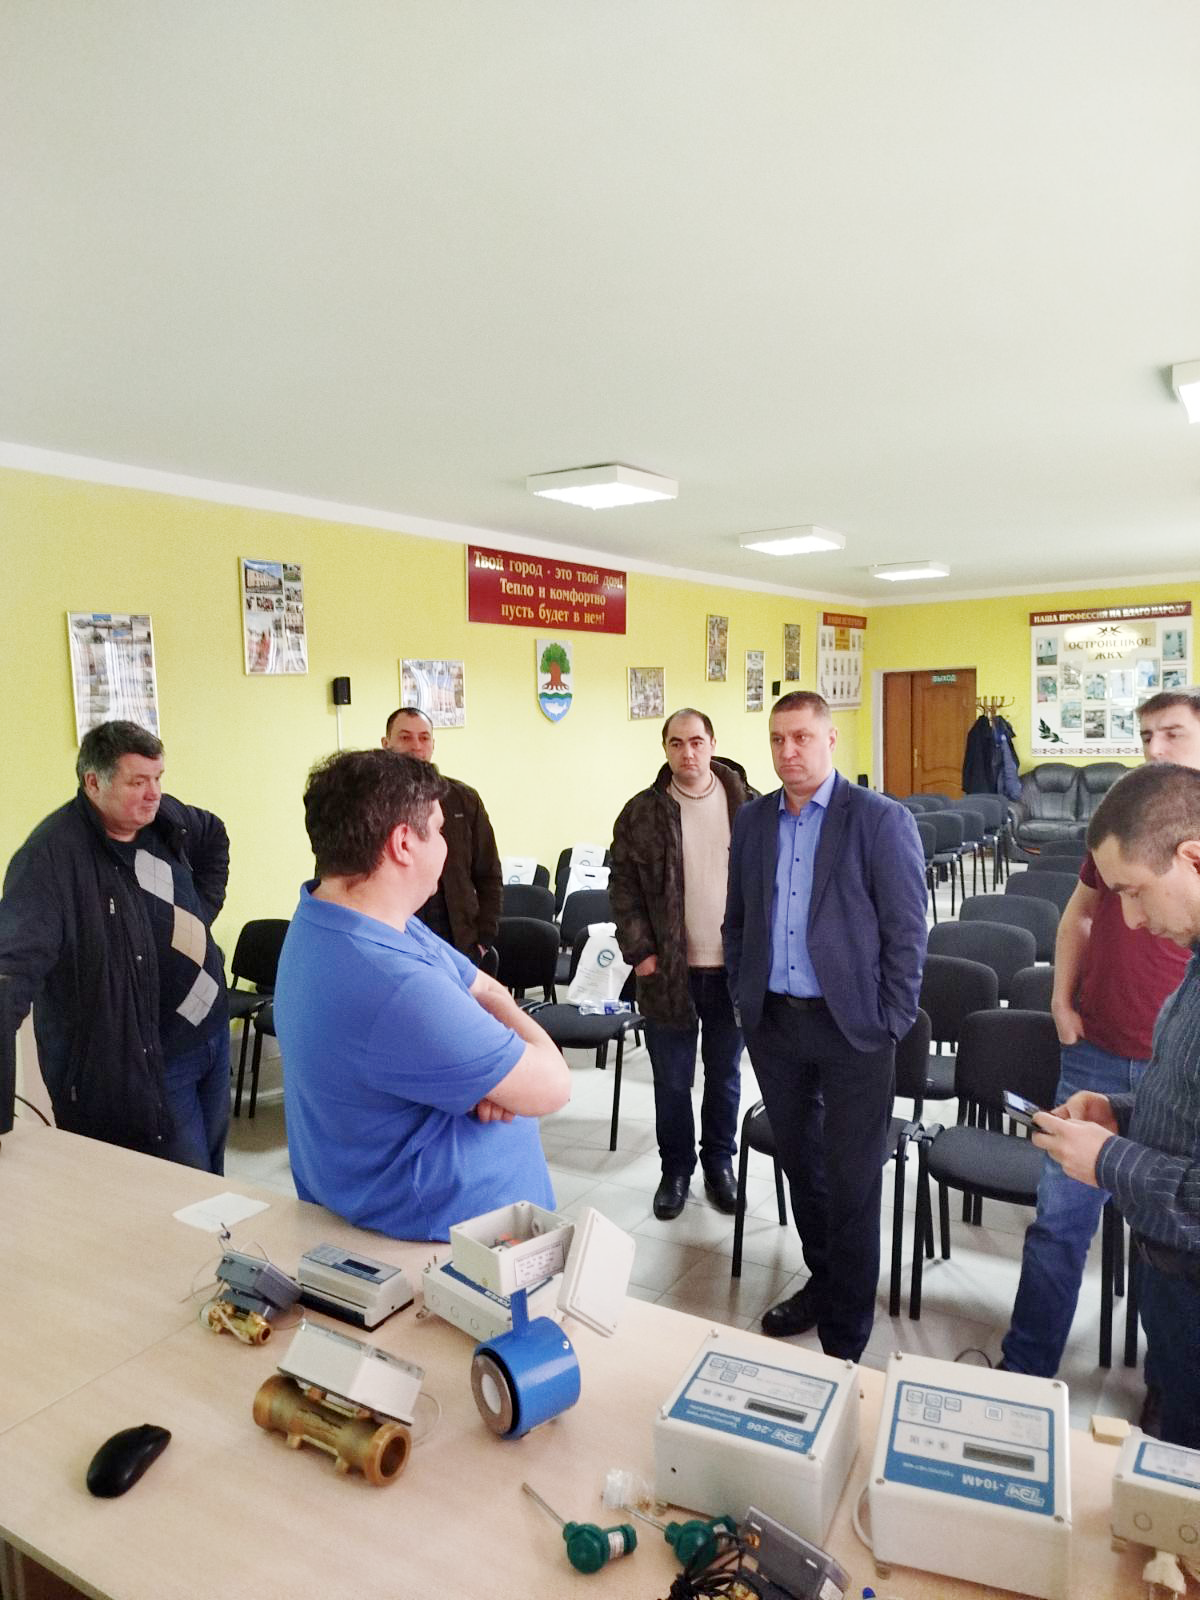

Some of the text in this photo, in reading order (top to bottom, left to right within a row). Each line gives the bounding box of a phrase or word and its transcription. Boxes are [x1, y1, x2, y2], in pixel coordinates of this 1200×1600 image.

[474, 551, 504, 571] Твой
[509, 560, 543, 578] город
[555, 567, 572, 581] это
[576, 570, 599, 585] твой
[500, 577, 606, 607] Тепло и комфортно
[501, 603, 605, 625] пусть будет в нем!
[1034, 614, 1058, 624] НАША
[1059, 610, 1109, 622] ПРОФЕССИЯ
[1109, 608, 1121, 618] НА
